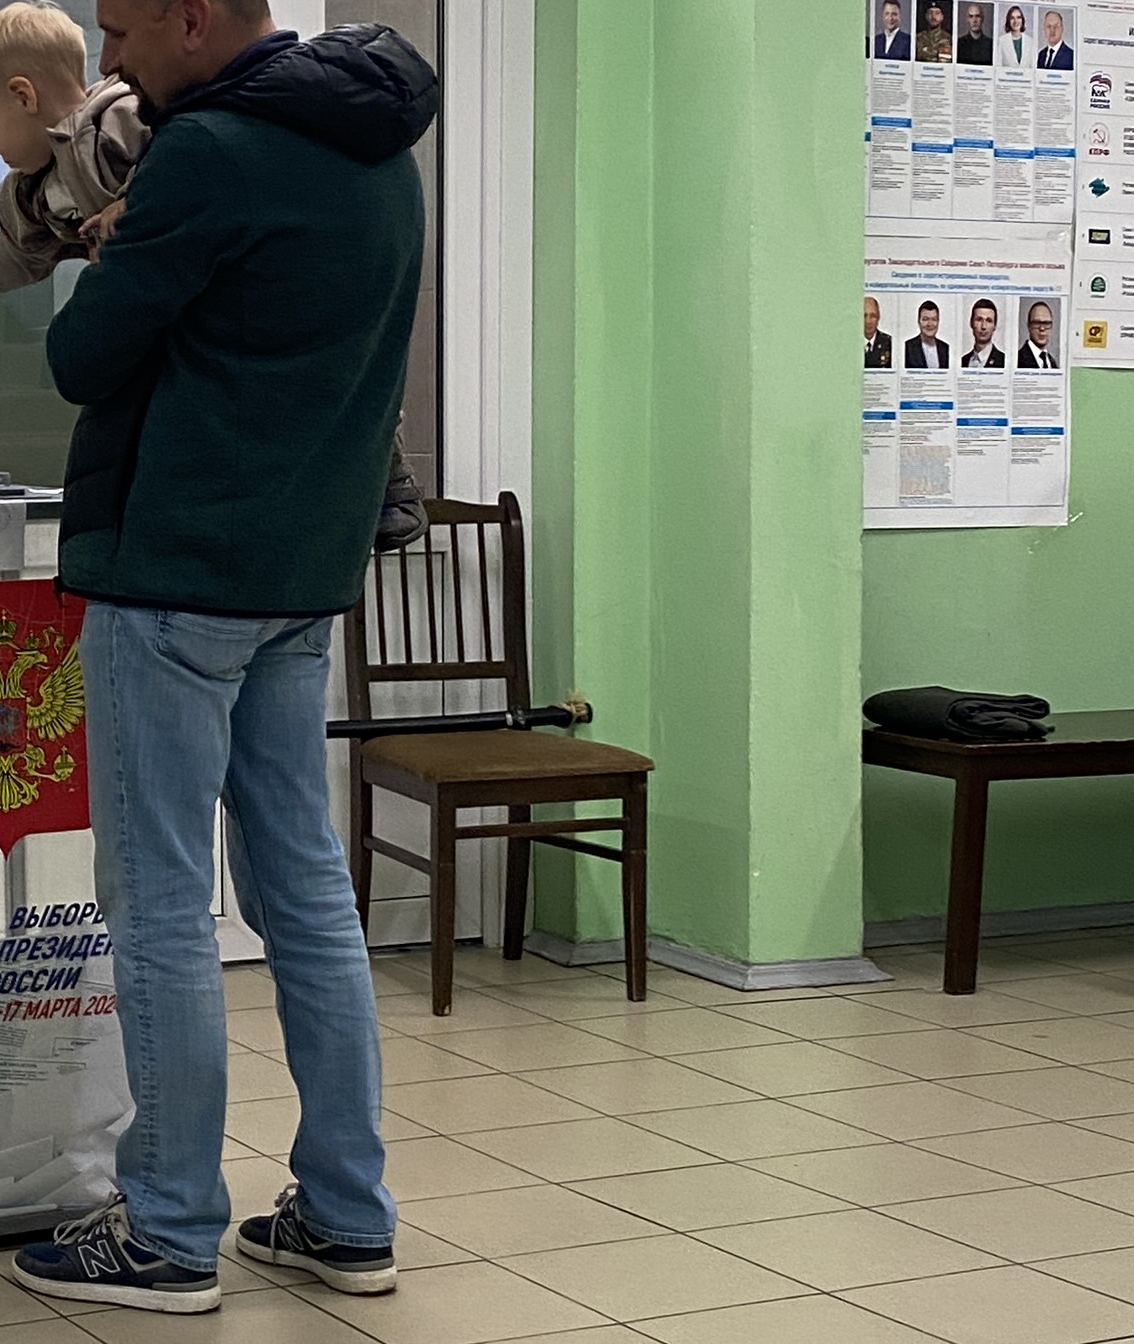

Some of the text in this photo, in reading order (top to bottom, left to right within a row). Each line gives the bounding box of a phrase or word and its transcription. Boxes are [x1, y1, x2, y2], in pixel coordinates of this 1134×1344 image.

[22, 997, 82, 1021] МАРТА
[83, 994, 117, 1017] 202
[77, 1239, 123, 1278] N
